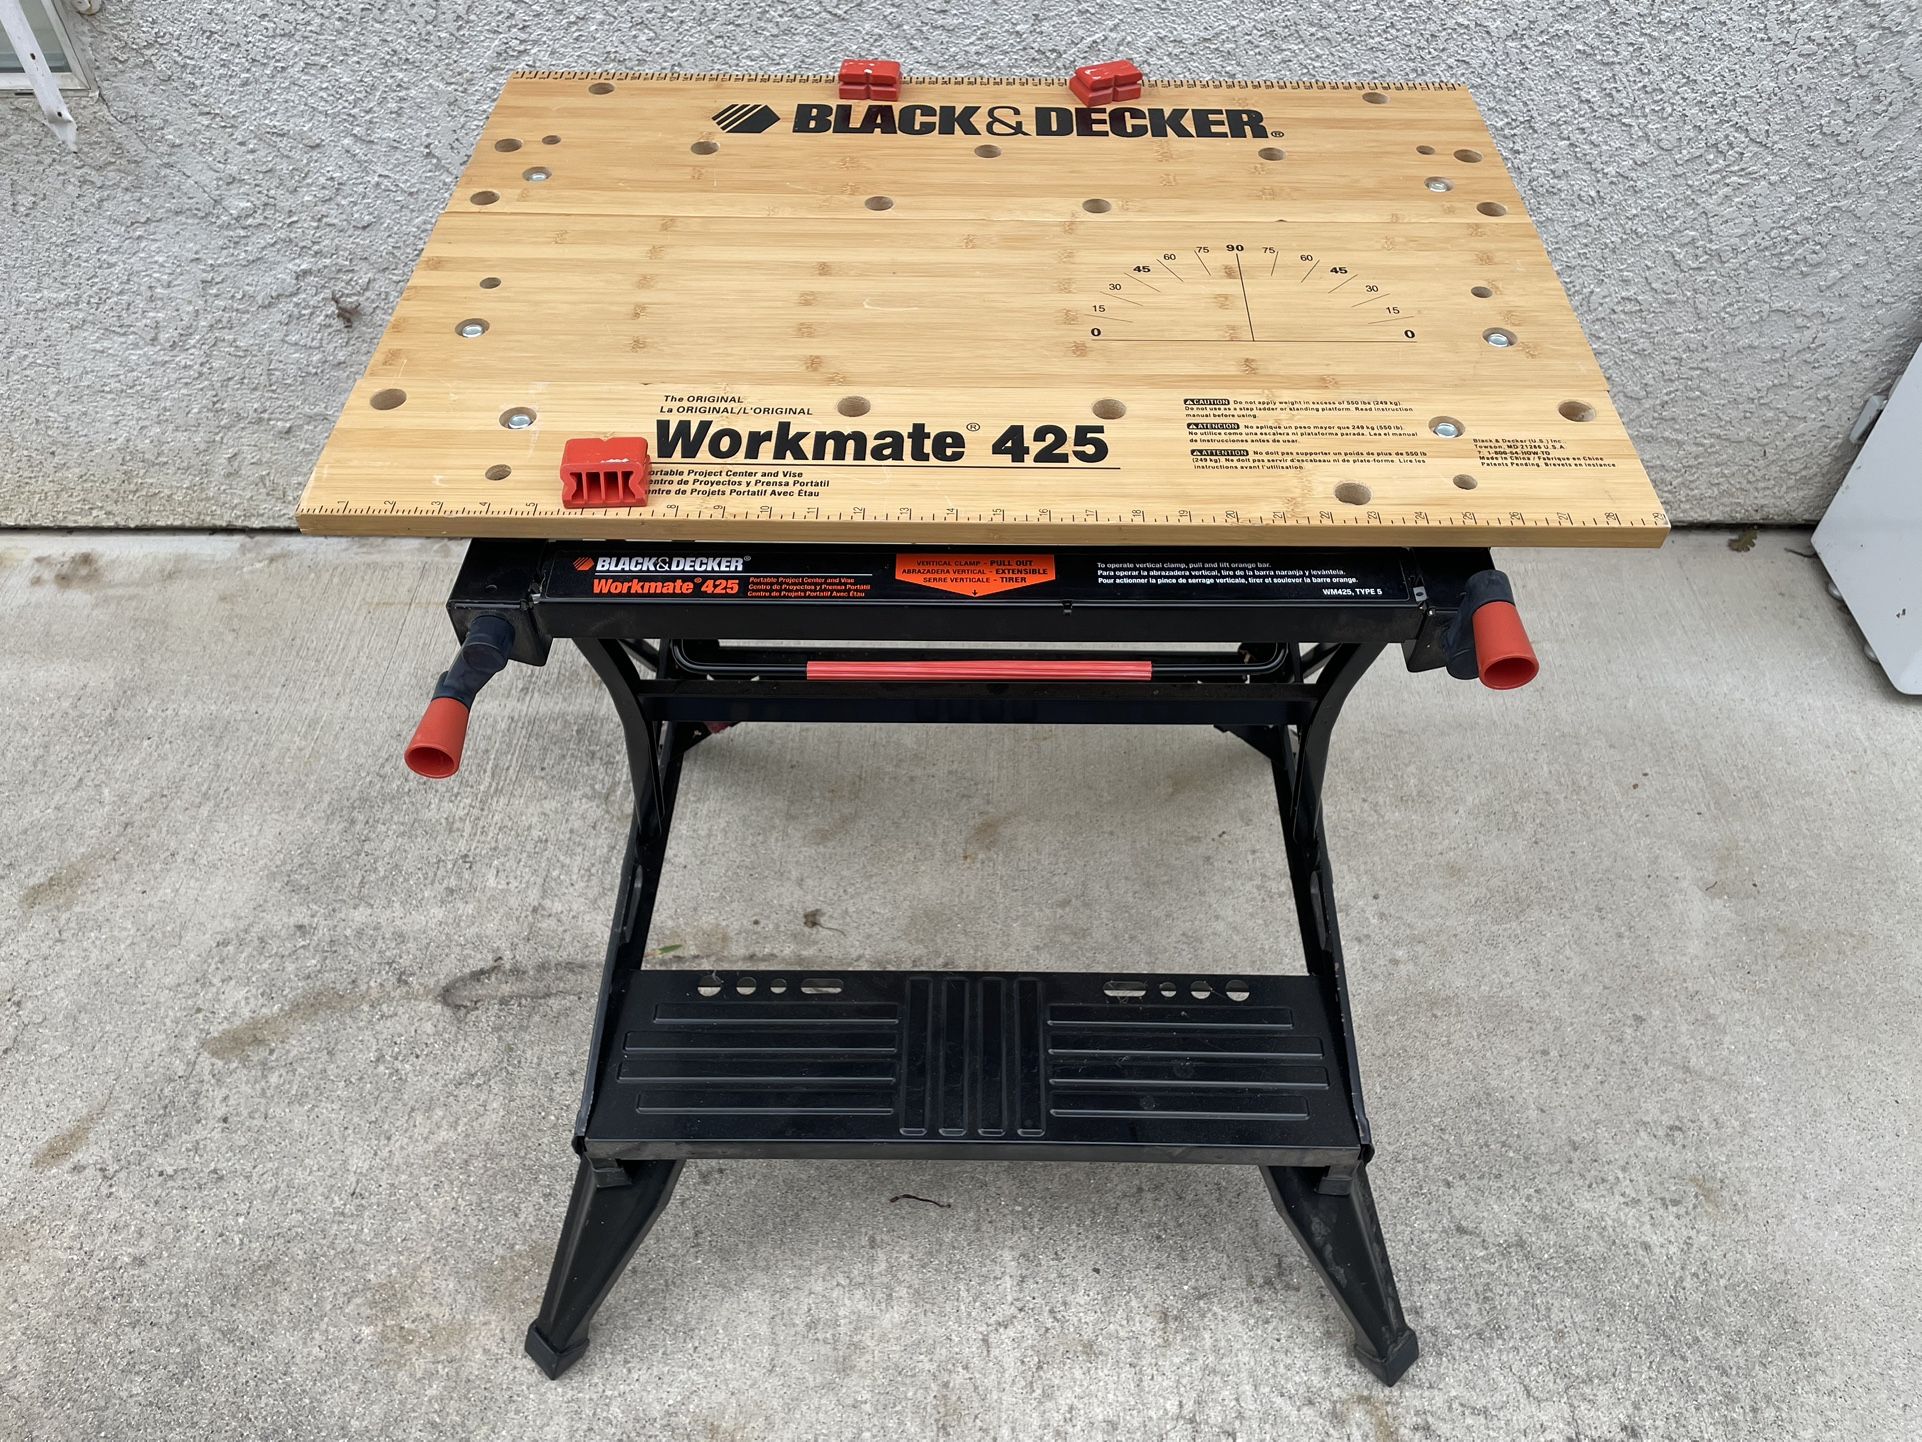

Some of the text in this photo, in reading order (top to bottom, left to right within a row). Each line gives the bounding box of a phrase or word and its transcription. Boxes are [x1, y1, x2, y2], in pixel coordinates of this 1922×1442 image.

[1196, 246, 1210, 254] 75
[1225, 244, 1244, 252] 90
[1262, 246, 1276, 254] 75
[1163, 253, 1177, 262] 60
[1300, 254, 1313, 262] 60
[1132, 265, 1151, 274] 45
[1329, 266, 1348, 275] 45
[1108, 283, 1122, 292] 30
[1365, 284, 1379, 293] 30
[1092, 305, 1106, 313] 15
[1386, 306, 1400, 315] 15
[1090, 327, 1102, 337] 0
[1404, 329, 1416, 340] 0
[664, 395, 744, 403] The ORIGINAL
[659, 406, 813, 416] La ORIGINAL/L'ORIGINAL
[991, 424, 1109, 464] 425
[648, 469, 803, 478] ortable Project Center and Vise
[676, 478, 690, 486] de
[692, 478, 743, 488] Proyectos
[745, 480, 752, 488] y
[754, 479, 790, 487] Prensa
[674, 488, 687, 496] de
[689, 488, 727, 497] Projets
[729, 488, 768, 497] Portatif
[769, 489, 795, 497] Avec
[1226, 510, 1236, 519] 20
[1273, 511, 1283, 519] 21
[1320, 511, 1331, 519] 22
[1368, 511, 1378, 519] 23
[1415, 512, 1425, 520] 24
[1463, 512, 1473, 520] 25
[1511, 512, 1521, 520] 26
[1605, 512, 1616, 521] 28
[701, 579, 739, 594] 425
[1322, 588, 1355, 596] WM425,
